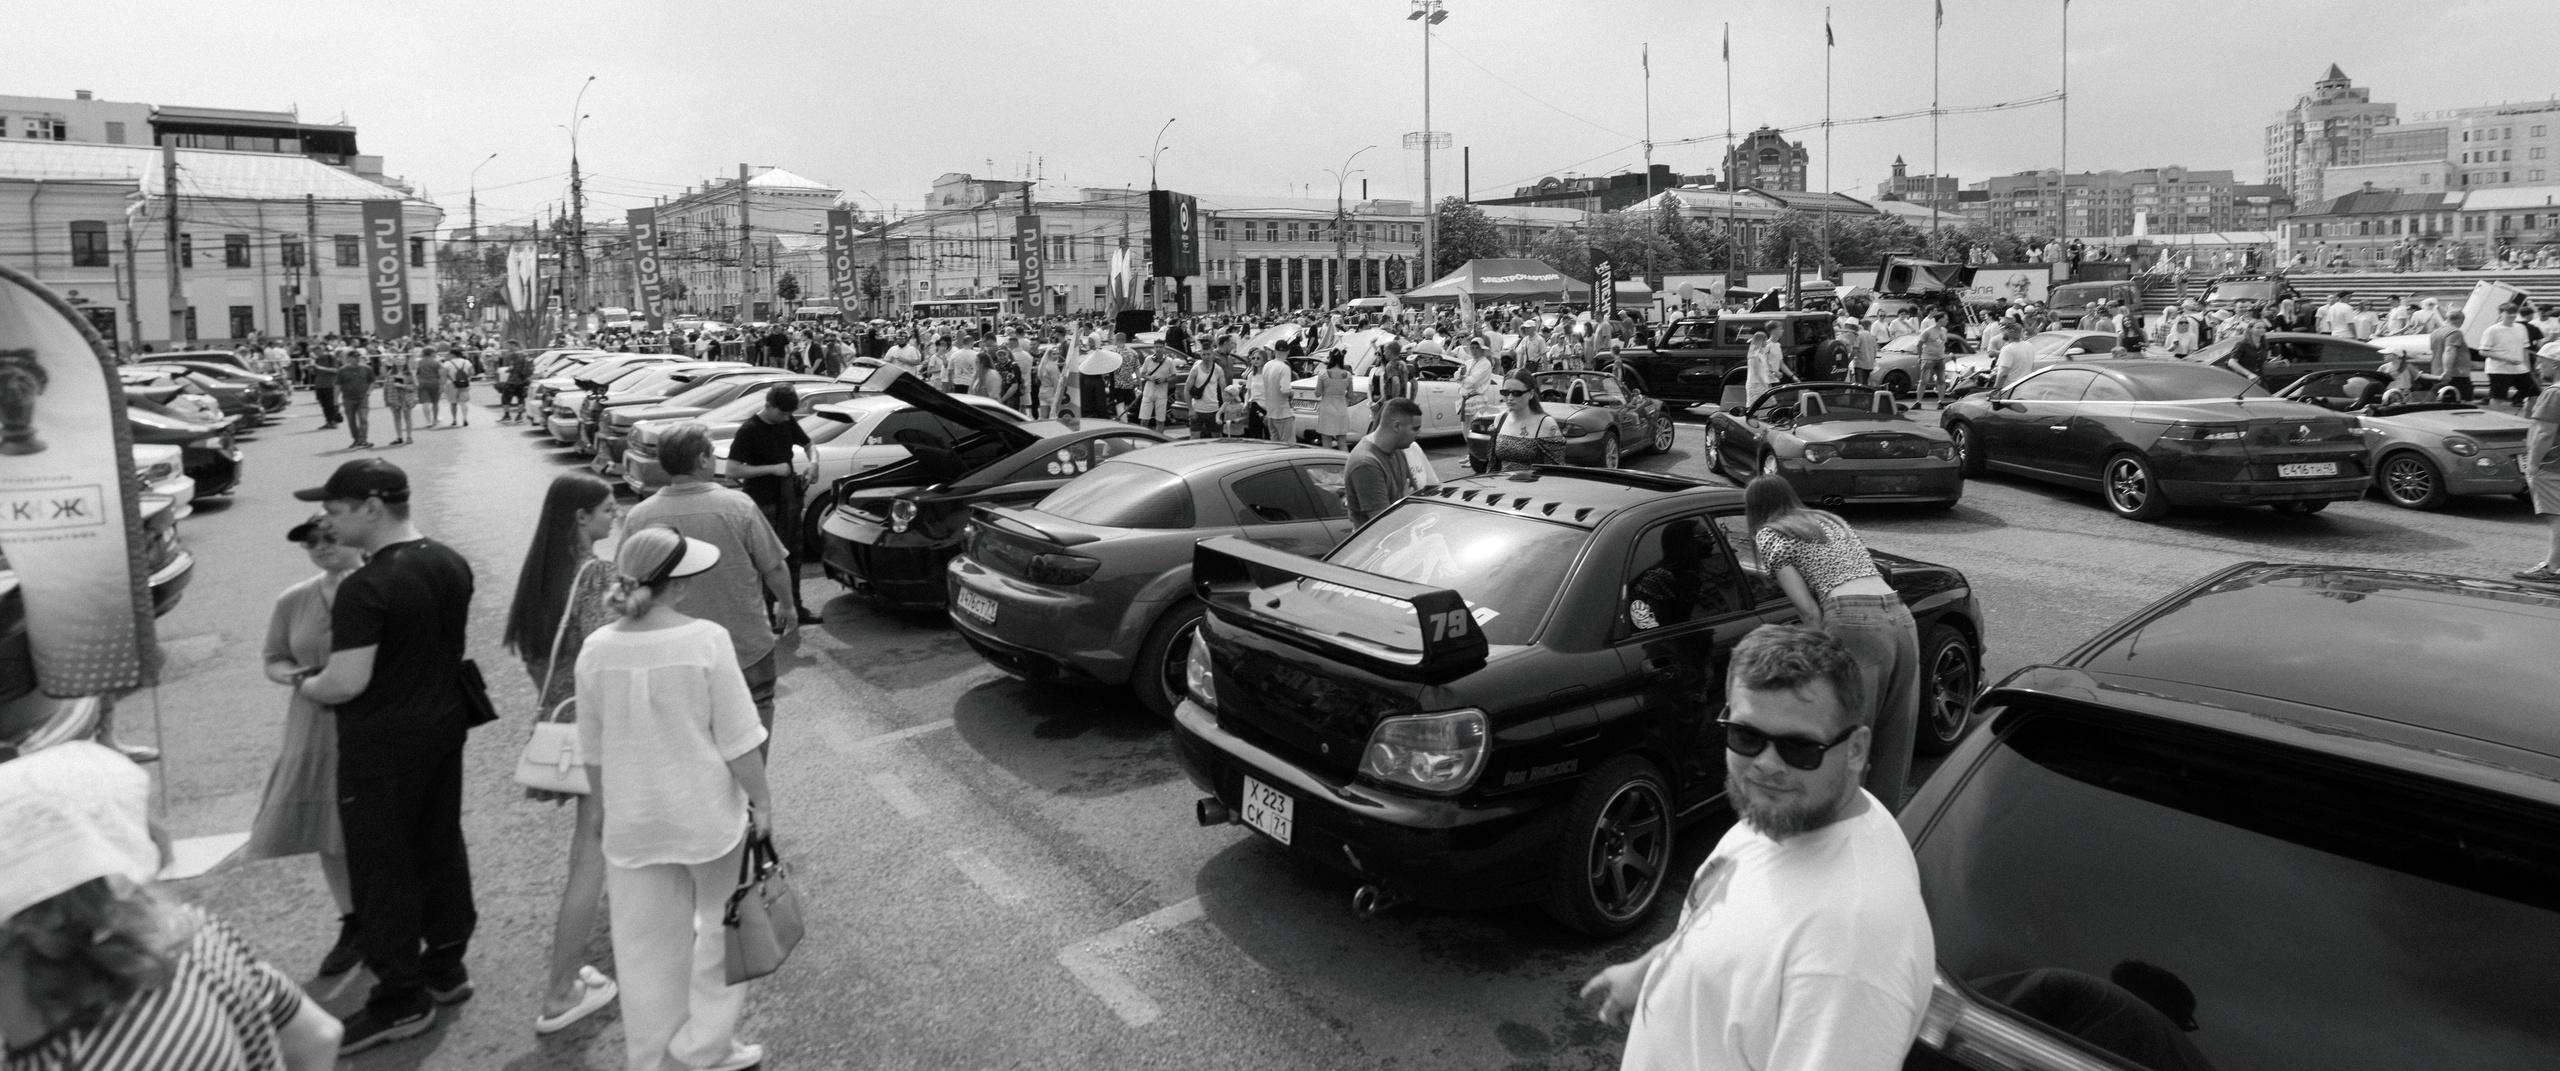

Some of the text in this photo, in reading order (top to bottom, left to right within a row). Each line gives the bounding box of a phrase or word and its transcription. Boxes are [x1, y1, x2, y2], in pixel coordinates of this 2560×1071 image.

[375, 219, 403, 325] auto.ru
[635, 223, 661, 318] auto.ru
[834, 225, 858, 311] auto.ru
[1023, 228, 1041, 307] auto.ru
[1429, 608, 1468, 643] 79
[1247, 803, 1287, 836] СК 71
[1262, 787, 1285, 814] 223
